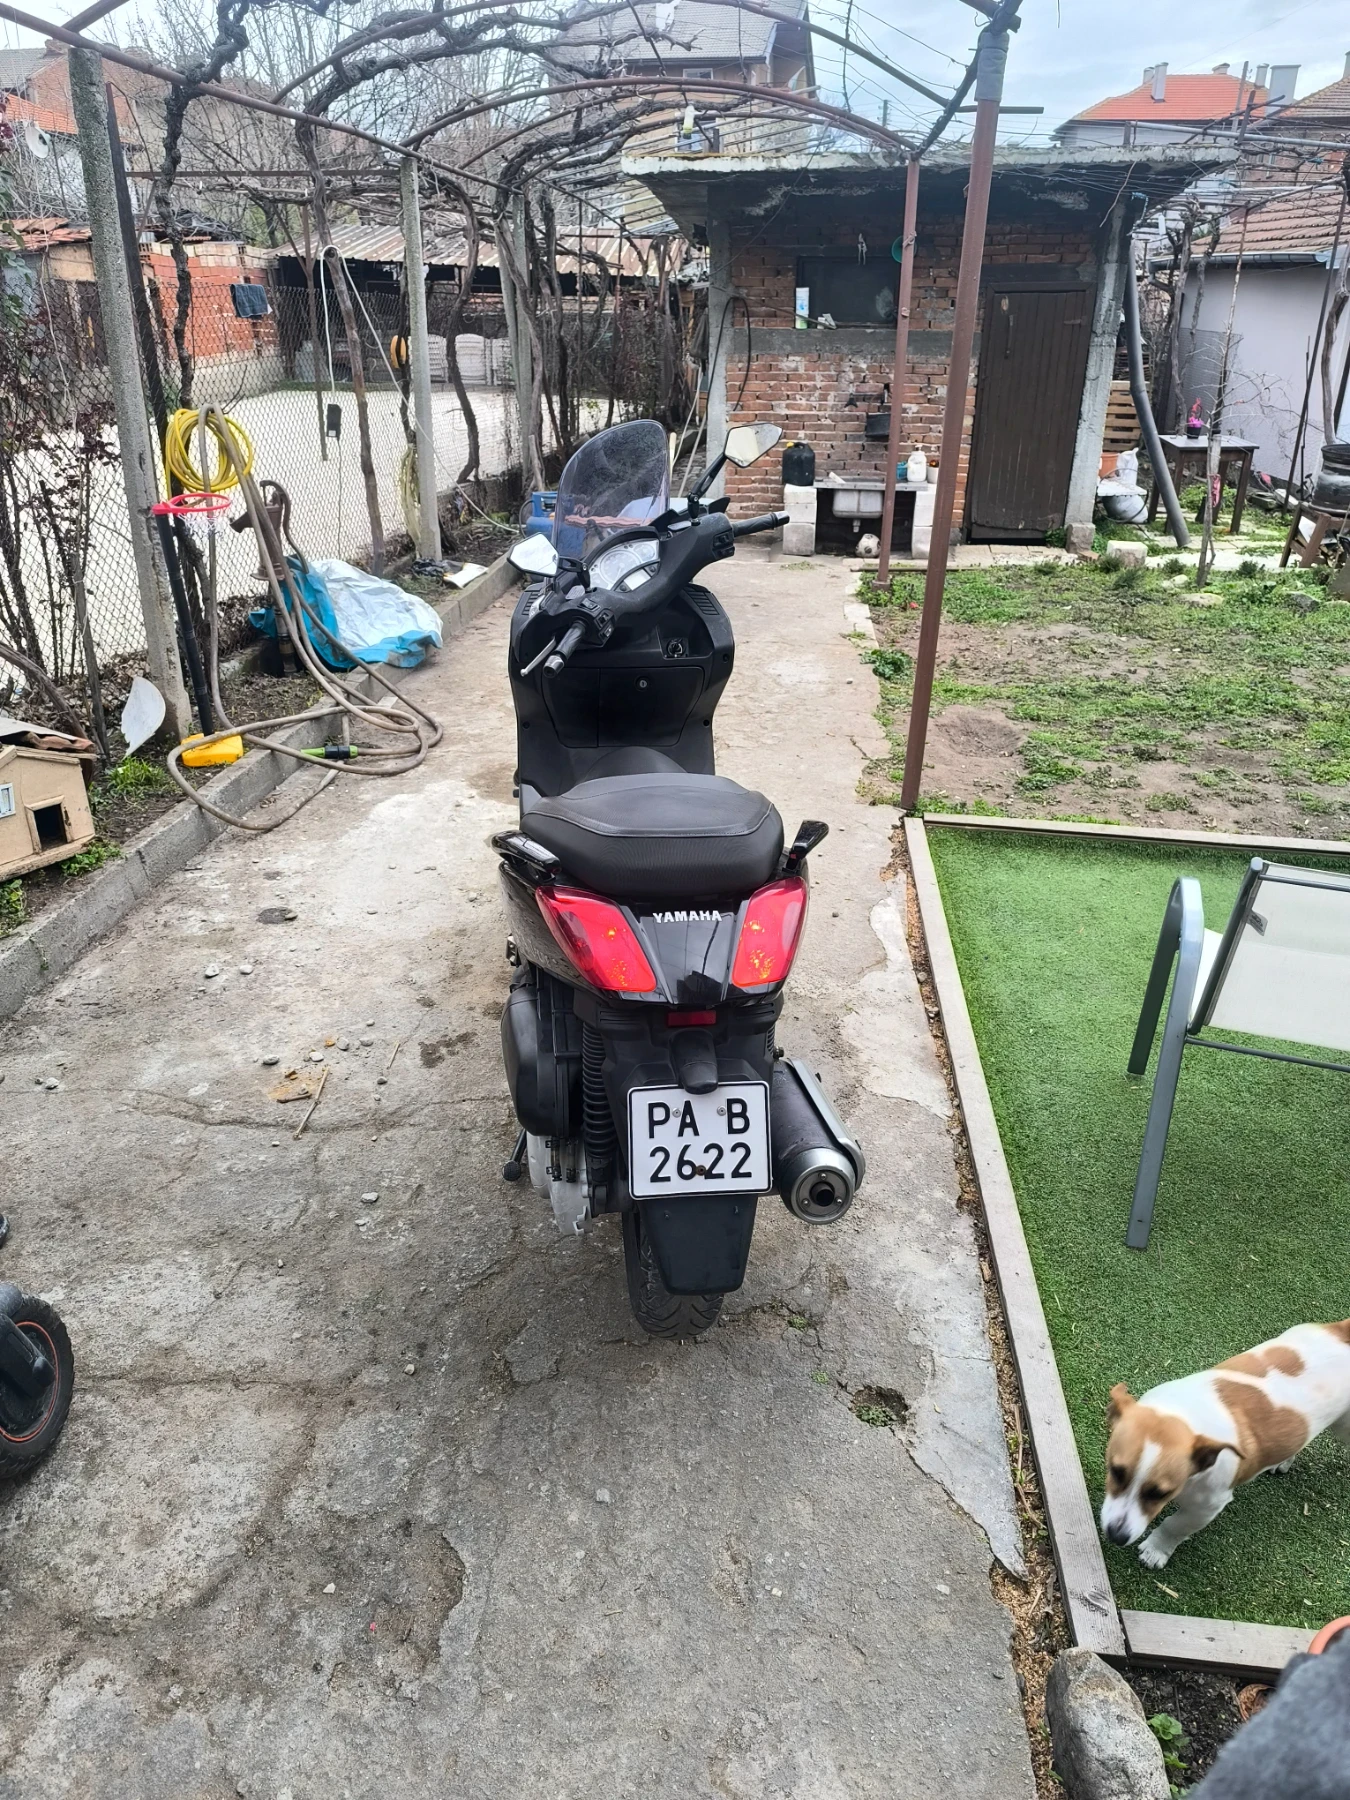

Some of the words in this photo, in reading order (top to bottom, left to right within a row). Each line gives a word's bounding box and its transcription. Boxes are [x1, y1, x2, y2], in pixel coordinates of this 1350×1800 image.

[652, 910, 722, 923] YAMAHA
[726, 1097, 751, 1135] B
[649, 1141, 753, 1183] 2622
